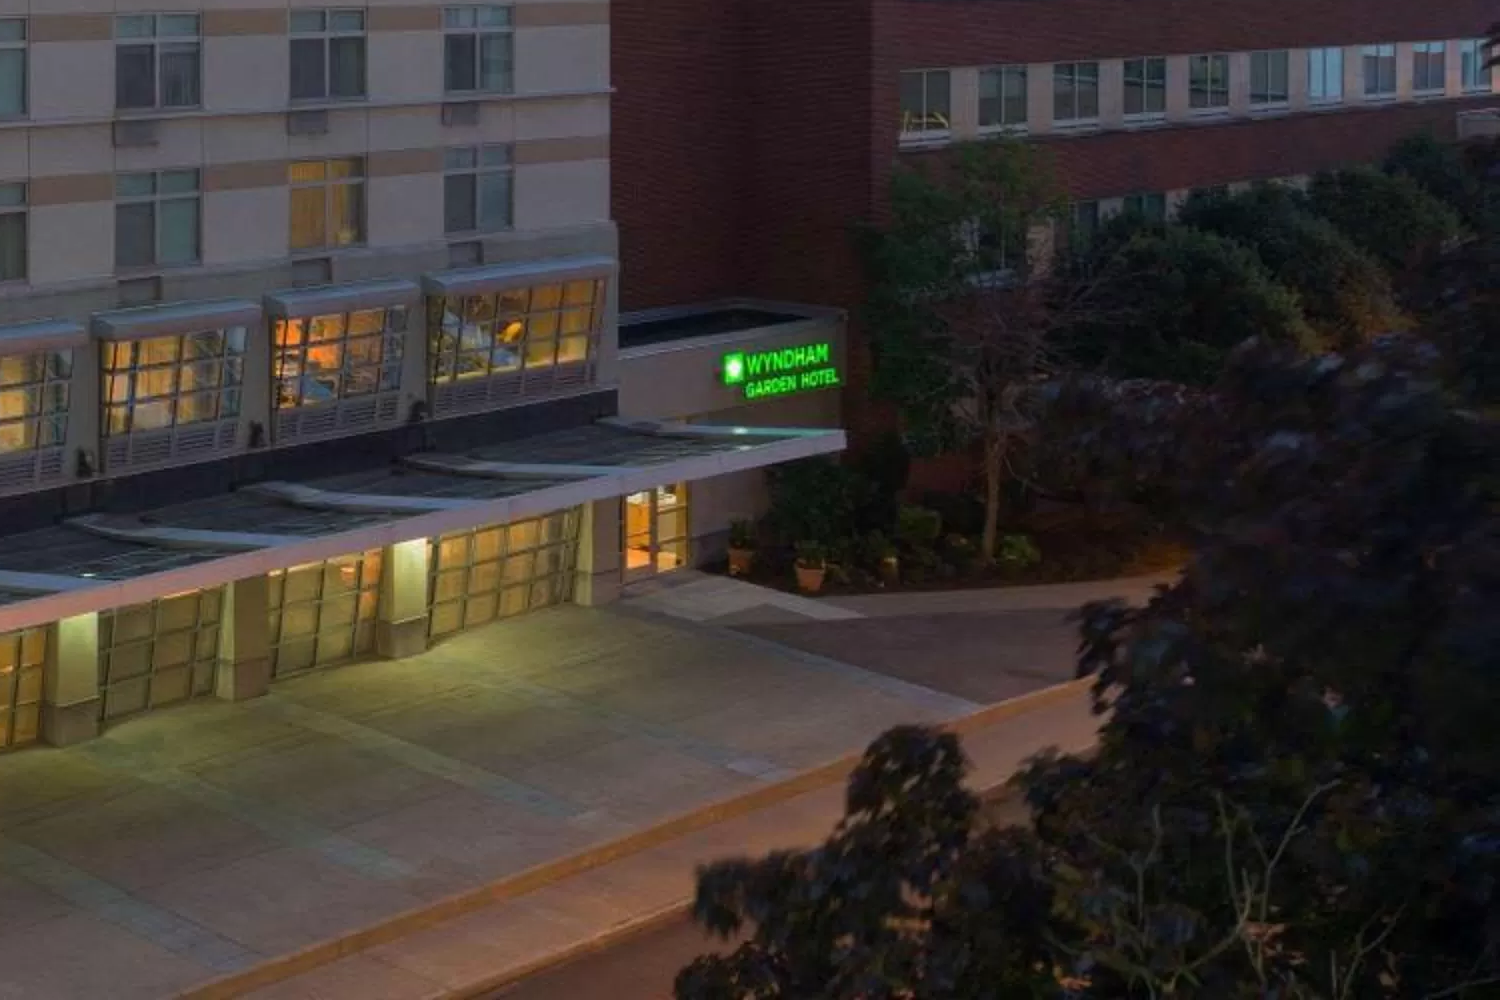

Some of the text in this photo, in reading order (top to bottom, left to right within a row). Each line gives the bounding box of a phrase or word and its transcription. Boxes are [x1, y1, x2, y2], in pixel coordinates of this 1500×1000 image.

[746, 343, 829, 374] WYNDHAM
[745, 367, 840, 398] GARDEN HOTEL
